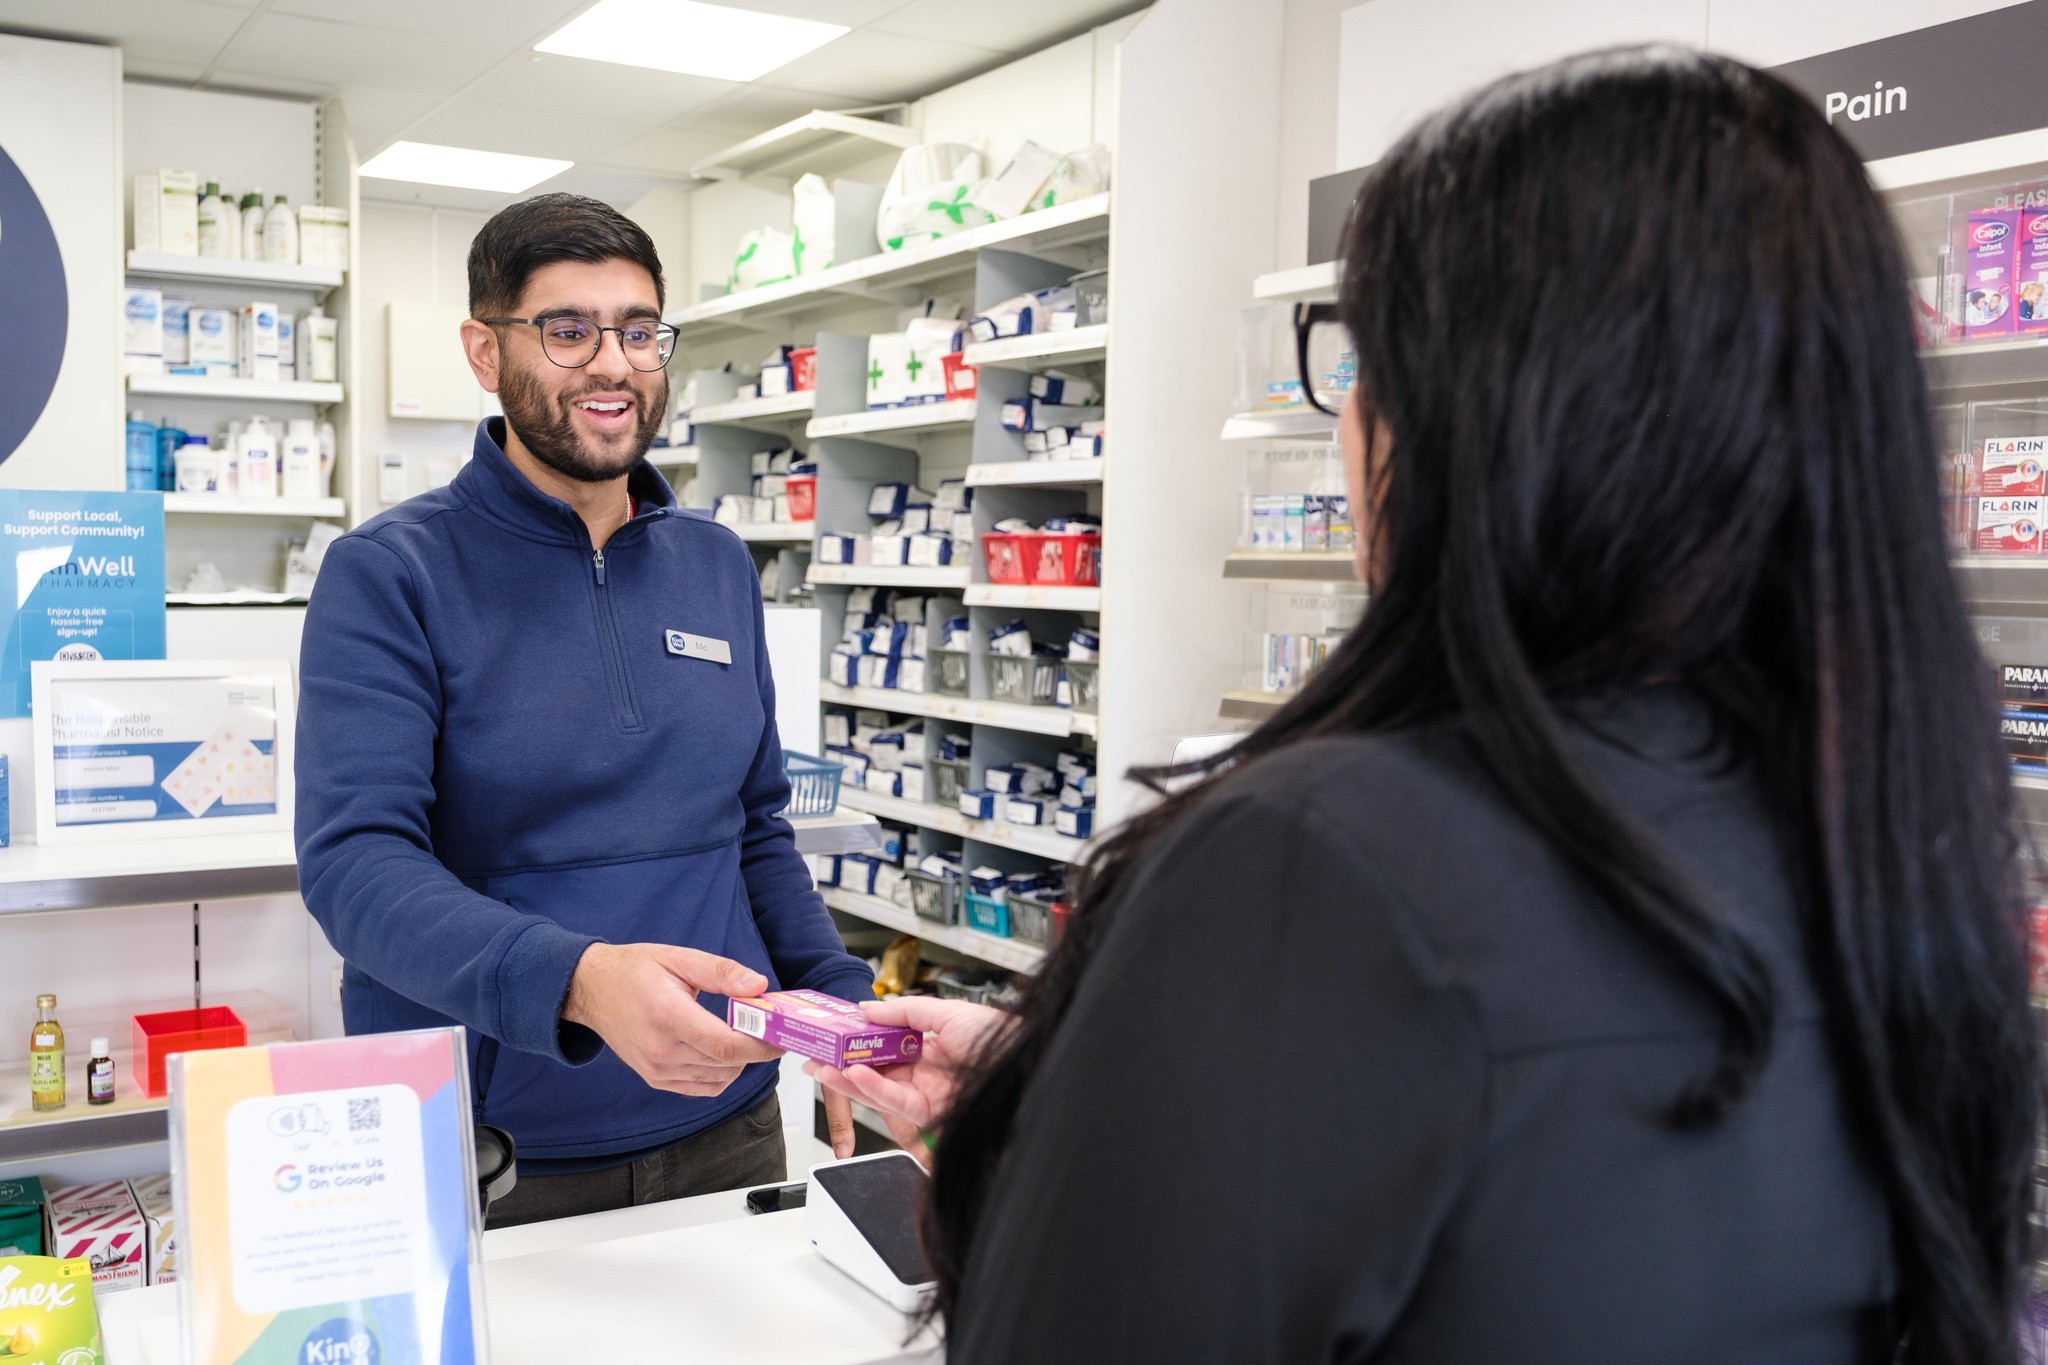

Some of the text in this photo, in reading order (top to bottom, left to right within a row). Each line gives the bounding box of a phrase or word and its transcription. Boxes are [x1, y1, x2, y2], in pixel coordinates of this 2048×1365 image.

[1825, 81, 1907, 125] Pain
[1994, 189, 2048, 214] PLEAS
[1978, 226, 2006, 239] Calpol
[1979, 243, 2002, 252] Infant
[1987, 441, 2043, 452] FLARIN
[1982, 500, 2037, 511] FLARIN
[28, 509, 122, 523] Support Local,
[4, 524, 144, 540] Support Community!
[40, 578, 136, 589] PHARMACY
[47, 607, 70, 617] Enjoy
[81, 607, 107, 617] quick
[51, 618, 103, 626] hassle-free
[57, 627, 97, 638] sign-up!
[695, 642, 708, 652] Mo
[75, 711, 151, 727] Resnsible
[125, 726, 164, 738] Notice
[791, 993, 859, 1014] Allevia
[849, 1036, 883, 1051] Allevia
[308, 1158, 384, 1174] Review Us
[308, 1171, 385, 1190] On Google
[112, 1269, 139, 1280] FRIEND
[306, 1336, 350, 1365] Kin
